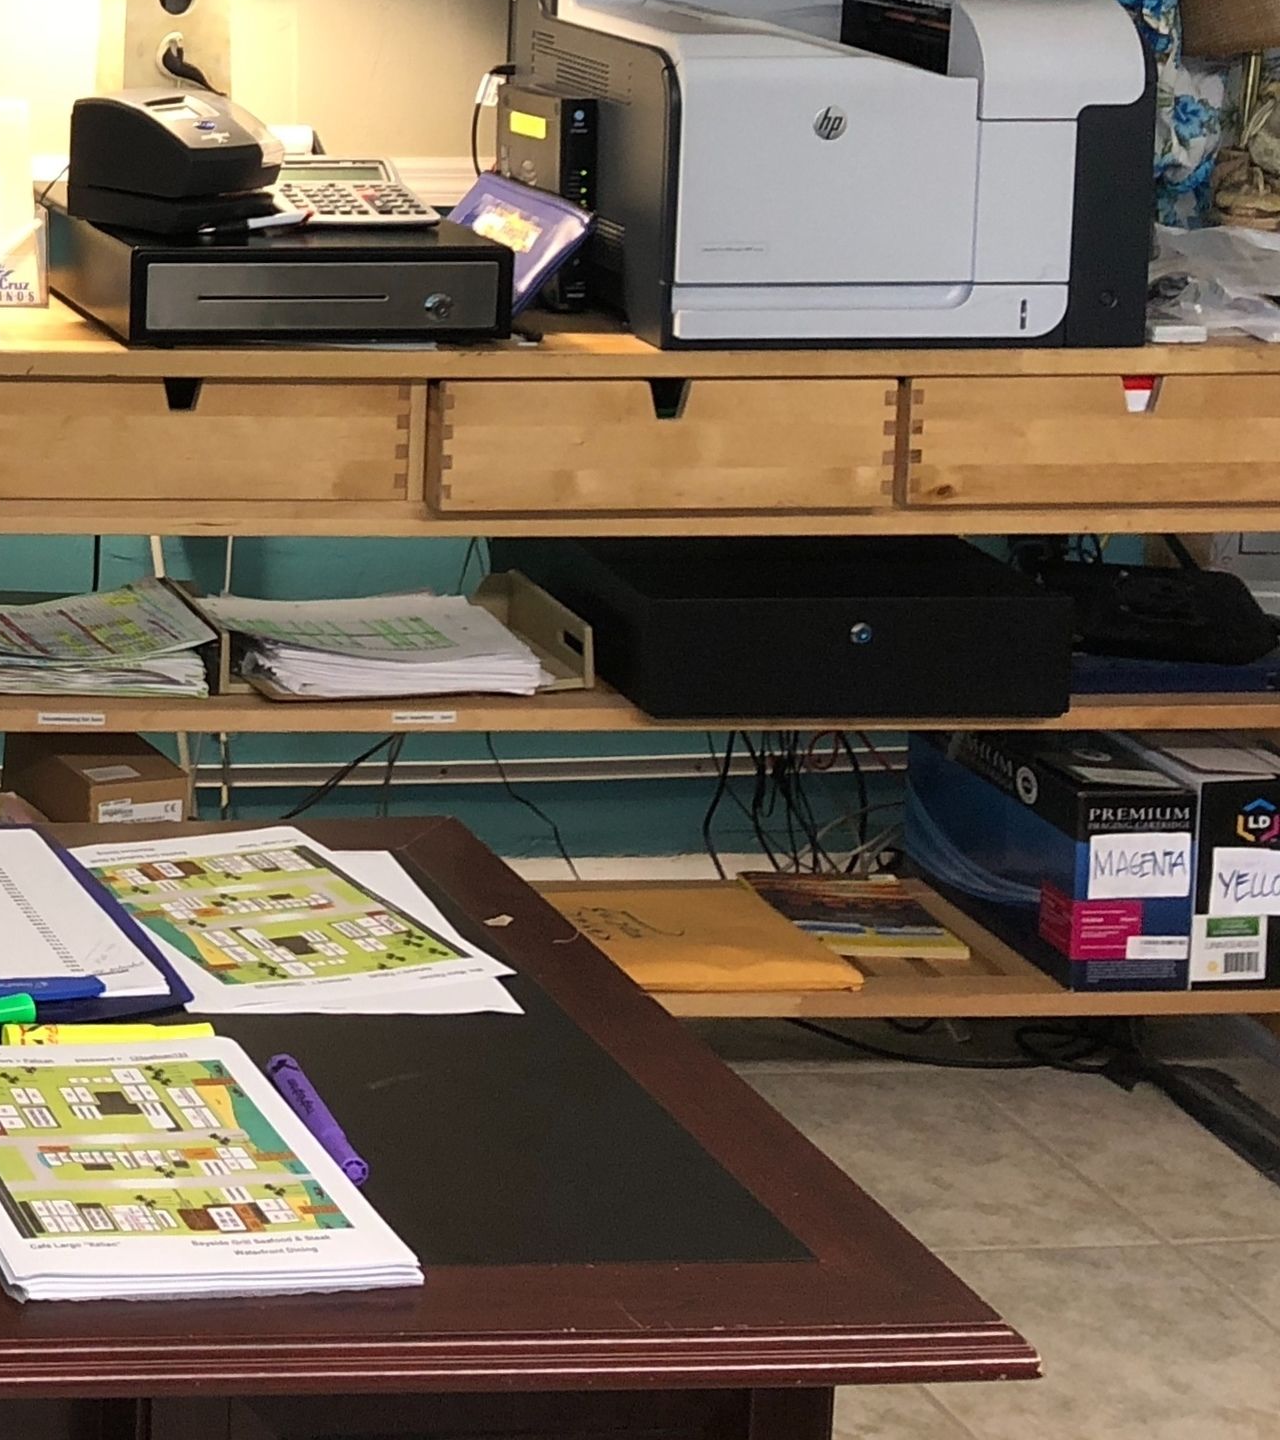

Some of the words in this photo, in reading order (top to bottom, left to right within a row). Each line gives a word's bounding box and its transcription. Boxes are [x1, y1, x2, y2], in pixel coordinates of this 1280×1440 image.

[818, 105, 844, 140] hp
[1089, 807, 1191, 822] PREMIUM
[1247, 815, 1271, 829] LD
[1093, 850, 1187, 880] MAGENTA
[1218, 868, 1280, 903] YELLO
